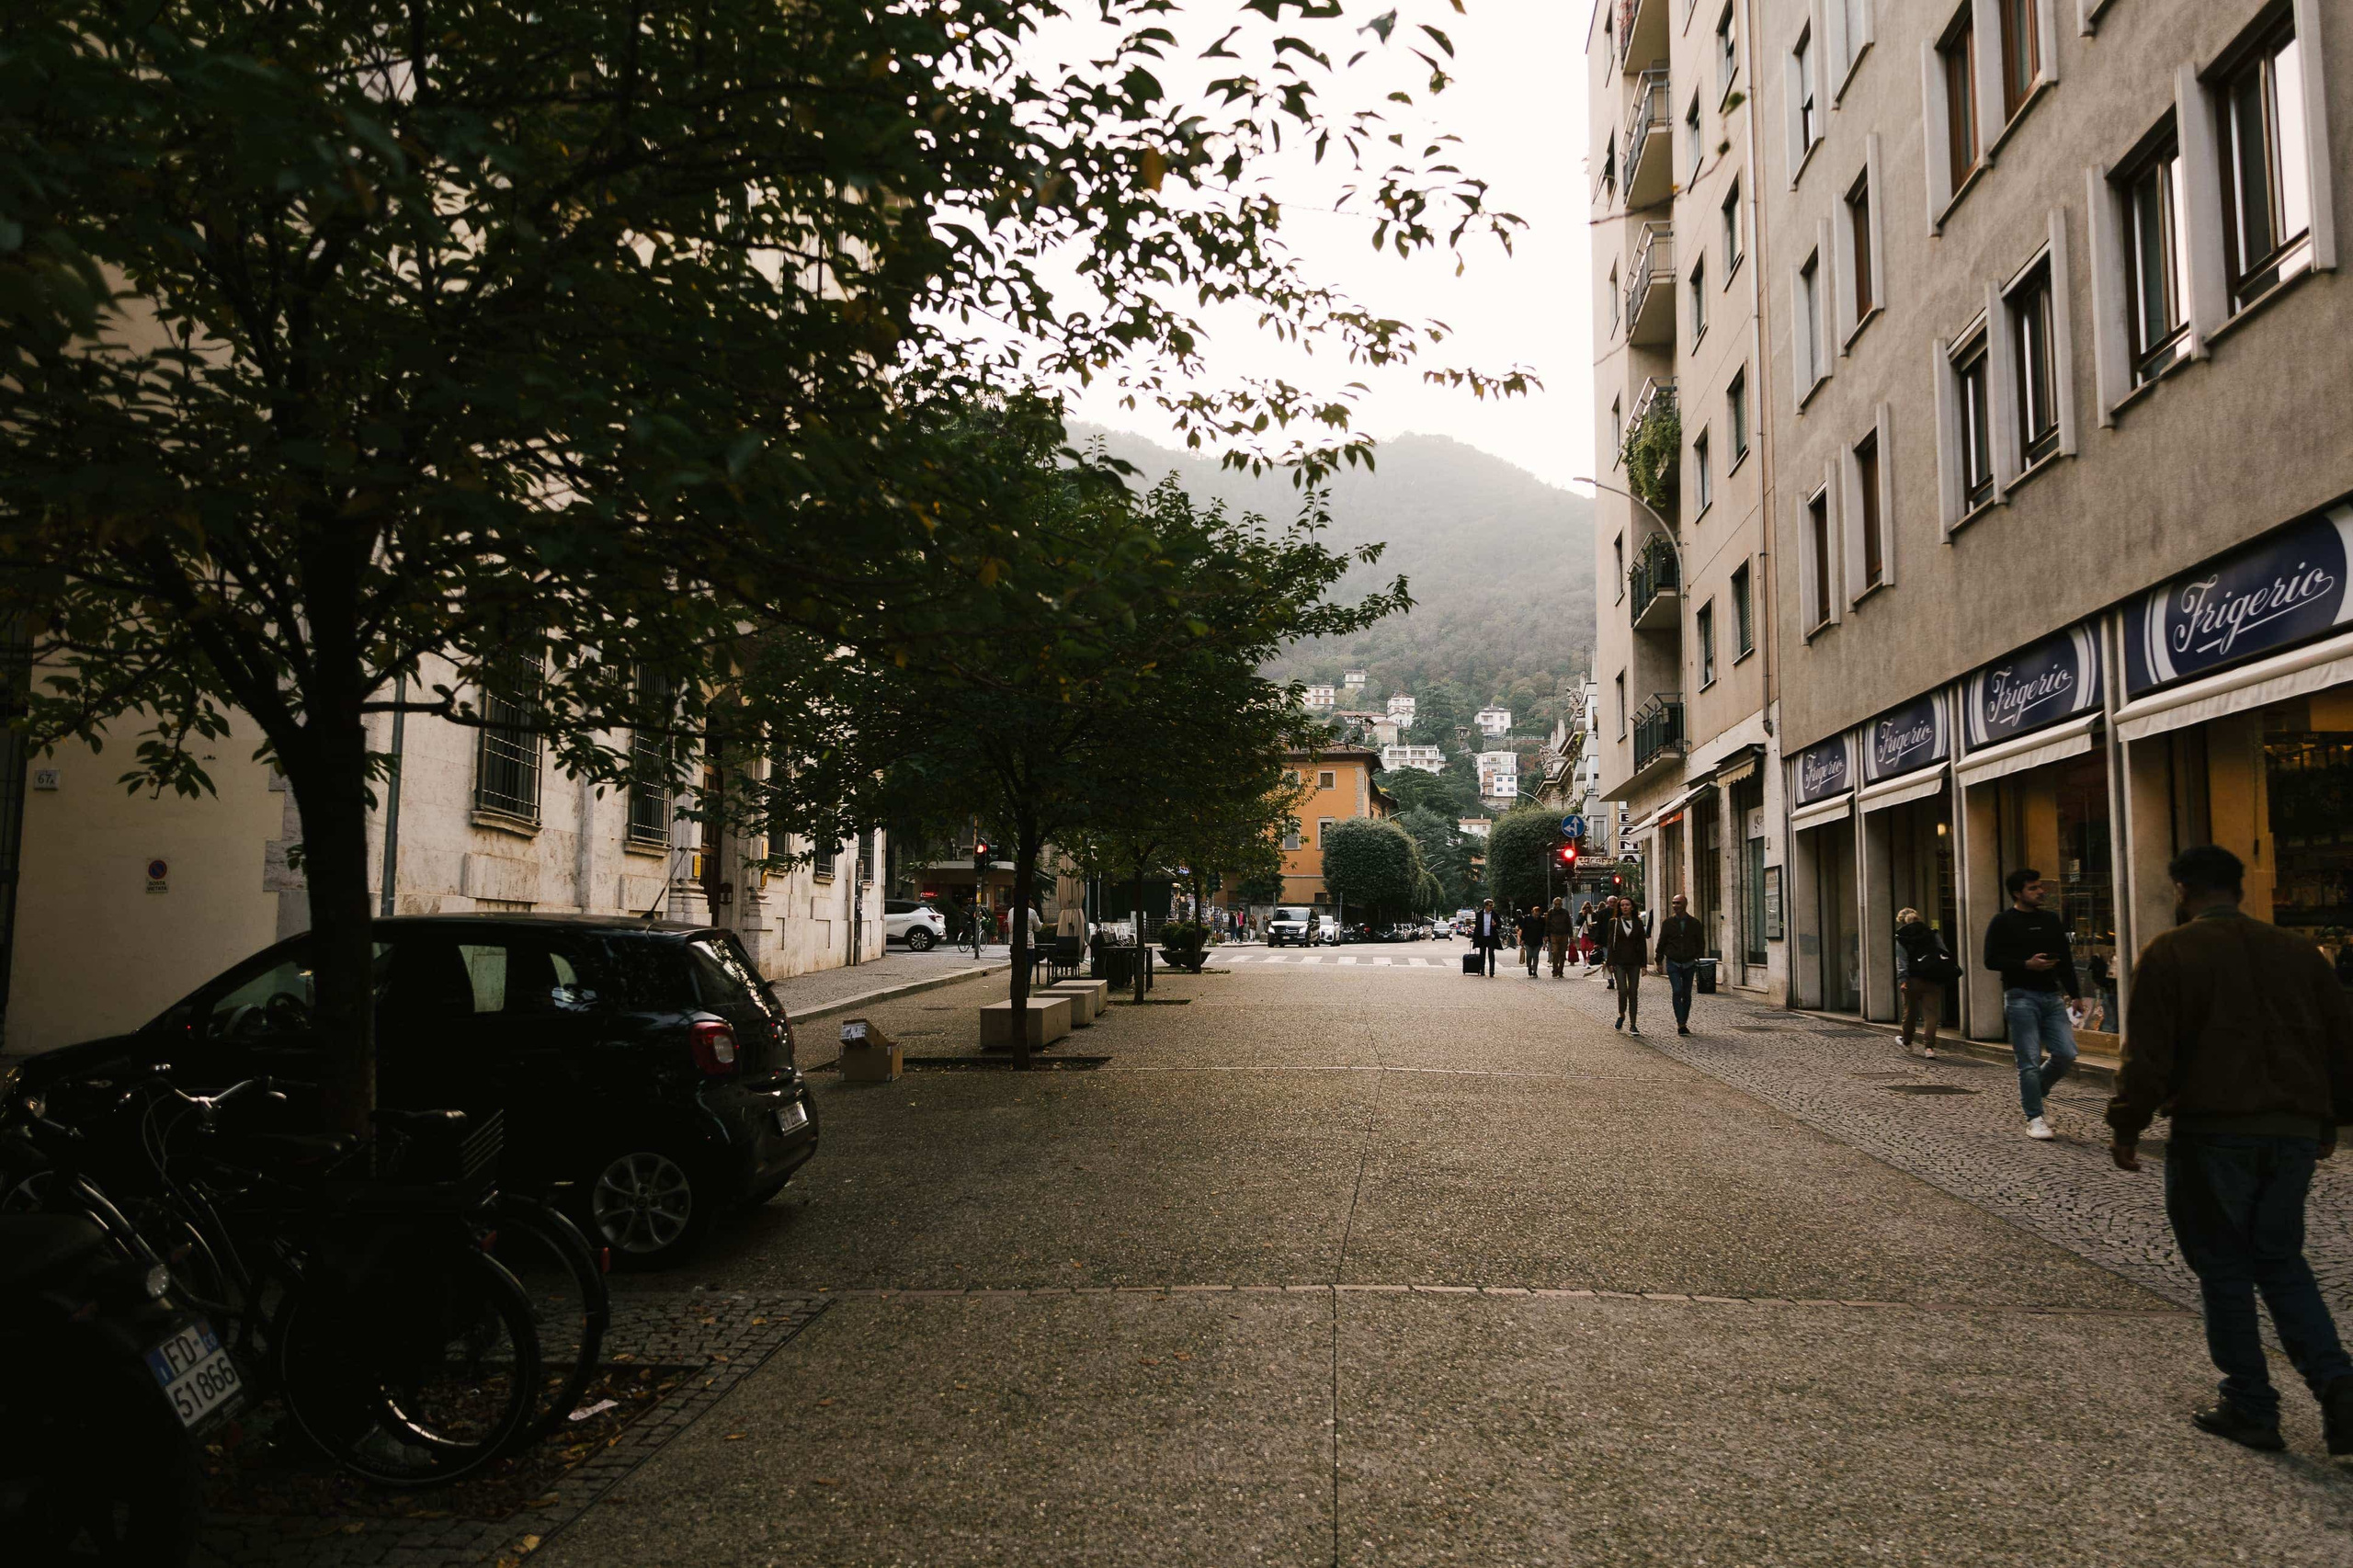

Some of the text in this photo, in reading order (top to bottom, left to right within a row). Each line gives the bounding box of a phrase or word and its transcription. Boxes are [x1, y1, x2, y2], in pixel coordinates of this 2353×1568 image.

[2173, 562, 2334, 654] Frigerio
[1986, 664, 2074, 727] Frigerio
[1877, 718, 1932, 767] Frigerio
[1804, 752, 1845, 793] Frigerio
[164, 1335, 197, 1374] FD
[174, 1357, 235, 1418] 51866
